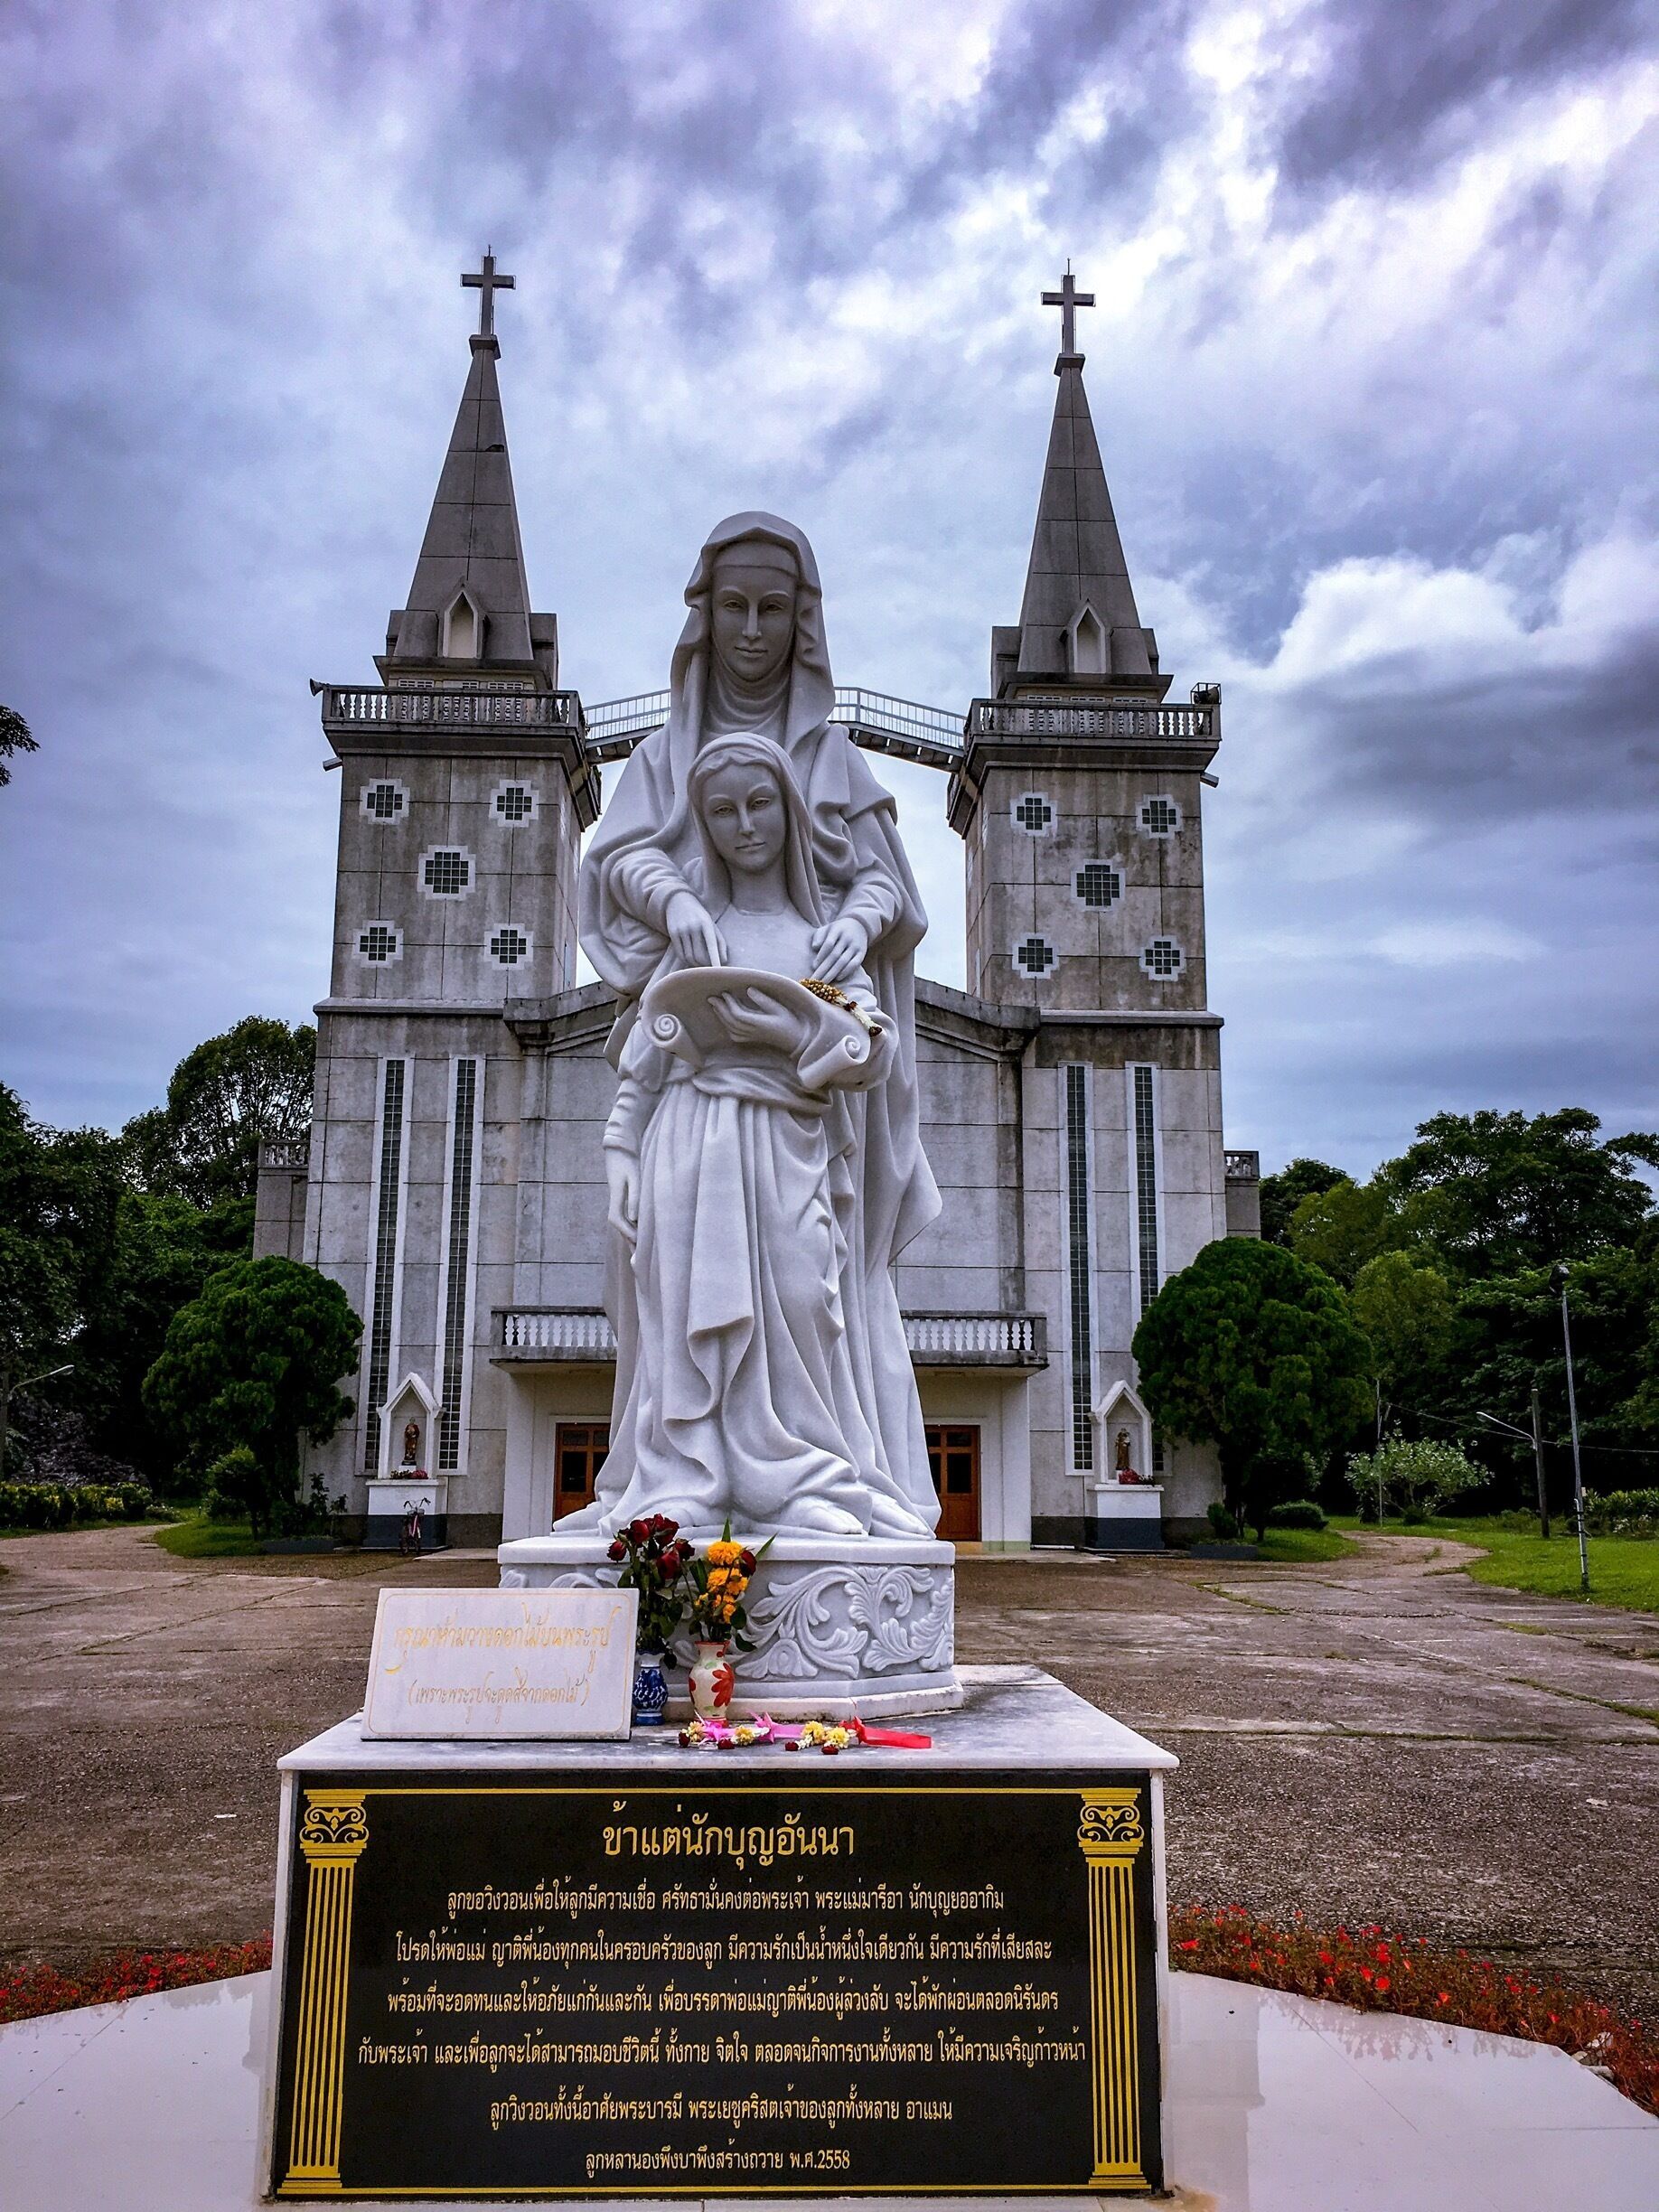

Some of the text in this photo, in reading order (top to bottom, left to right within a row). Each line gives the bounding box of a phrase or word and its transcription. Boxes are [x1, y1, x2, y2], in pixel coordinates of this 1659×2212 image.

[602, 1800, 854, 1871] ข้าแต่นักบุญอันนา
[447, 1875, 1004, 1920] ลูกขอวิงวอนเพื่อให้ลูกมีความเชื่อ ศรัทธามั่นคงต่อพระเจ้า พระแม่มารีอา นักบุญยออากิม
[396, 1925, 1052, 1970] โปรดให้พ่อแม่ ญาติพี่น้องทุกคนในครอบครัวของลูก มีความรักเป็นน้ำหนึ่งใจเดียวกัน มีความรักที่เสียสละ
[387, 1975, 1058, 2020] พร้อมที่จะอดทนและให้อภัยแก่กันและกัน เพื่อบรรดาพ่อแม่ญาติพี่น้องผู้ล่วงลับ จะได้พักผ่อนตลอดนิรันดร
[358, 2025, 1085, 2074] กับพระเจ้า และเพื่อลูกจะได้สามารถมอบชีวิตนี้ ทั้งกาย จิตใจ ตลอดจนกิจการงานทั้งหลาย ให้มีความเจริญก้าวหน้า
[491, 2083, 952, 2131] ลูกวิงวอนทั้งนี้อาศัยพระบารมี พระเยซูคริสตเจ้าของลูกทั้งหลาย อาแมน
[789, 2149, 850, 2170] พ.ศ.2558
